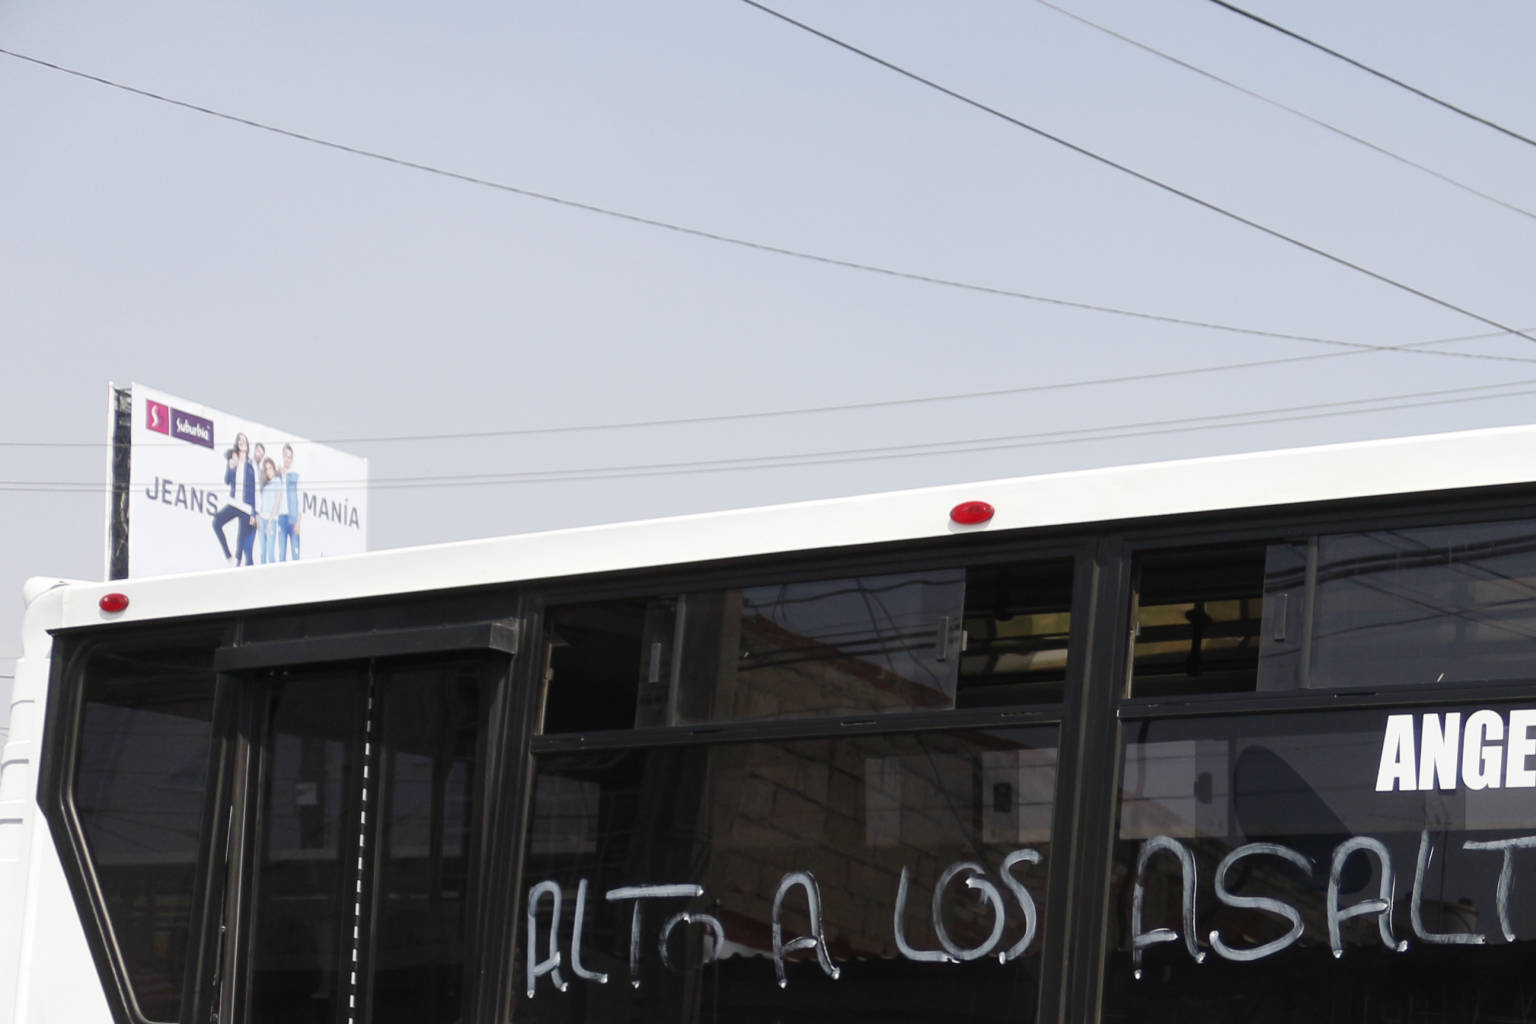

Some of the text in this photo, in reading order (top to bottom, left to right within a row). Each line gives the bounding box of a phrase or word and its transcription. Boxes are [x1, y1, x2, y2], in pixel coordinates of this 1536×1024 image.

[176, 417, 209, 441] Suburbia
[145, 475, 218, 516] JEANS
[527, 878, 724, 998] ALTO
[773, 870, 841, 989] A
[895, 848, 1044, 965] LOS
